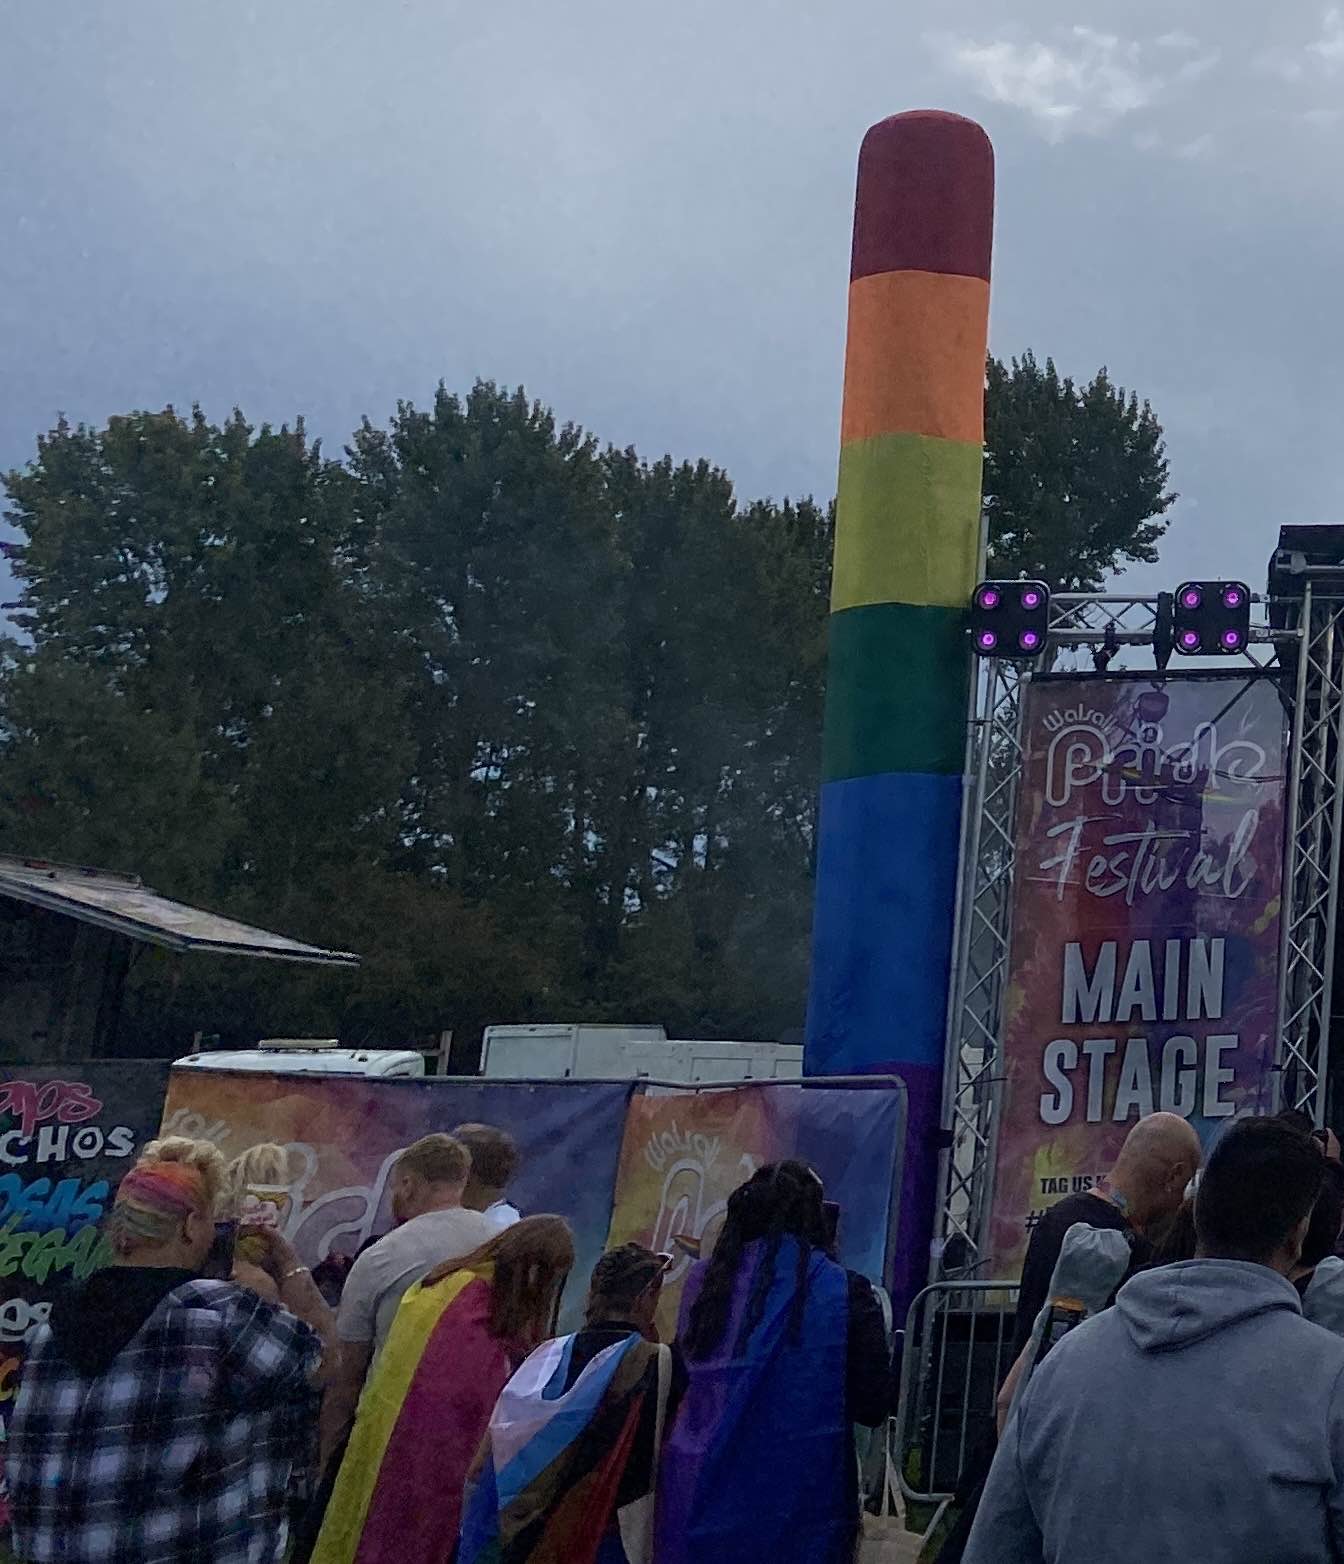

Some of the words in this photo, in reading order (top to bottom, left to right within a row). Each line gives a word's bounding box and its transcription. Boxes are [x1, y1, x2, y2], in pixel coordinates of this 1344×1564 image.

[1042, 702, 1119, 740] Walsall
[1046, 721, 1267, 808] Pride
[1040, 808, 1259, 906] Festival
[1061, 937, 1226, 1025] MAIN
[1039, 1034, 1239, 1125] STAGE
[1040, 1177, 1069, 1194] TAG
[1072, 1176, 1093, 1193] US
